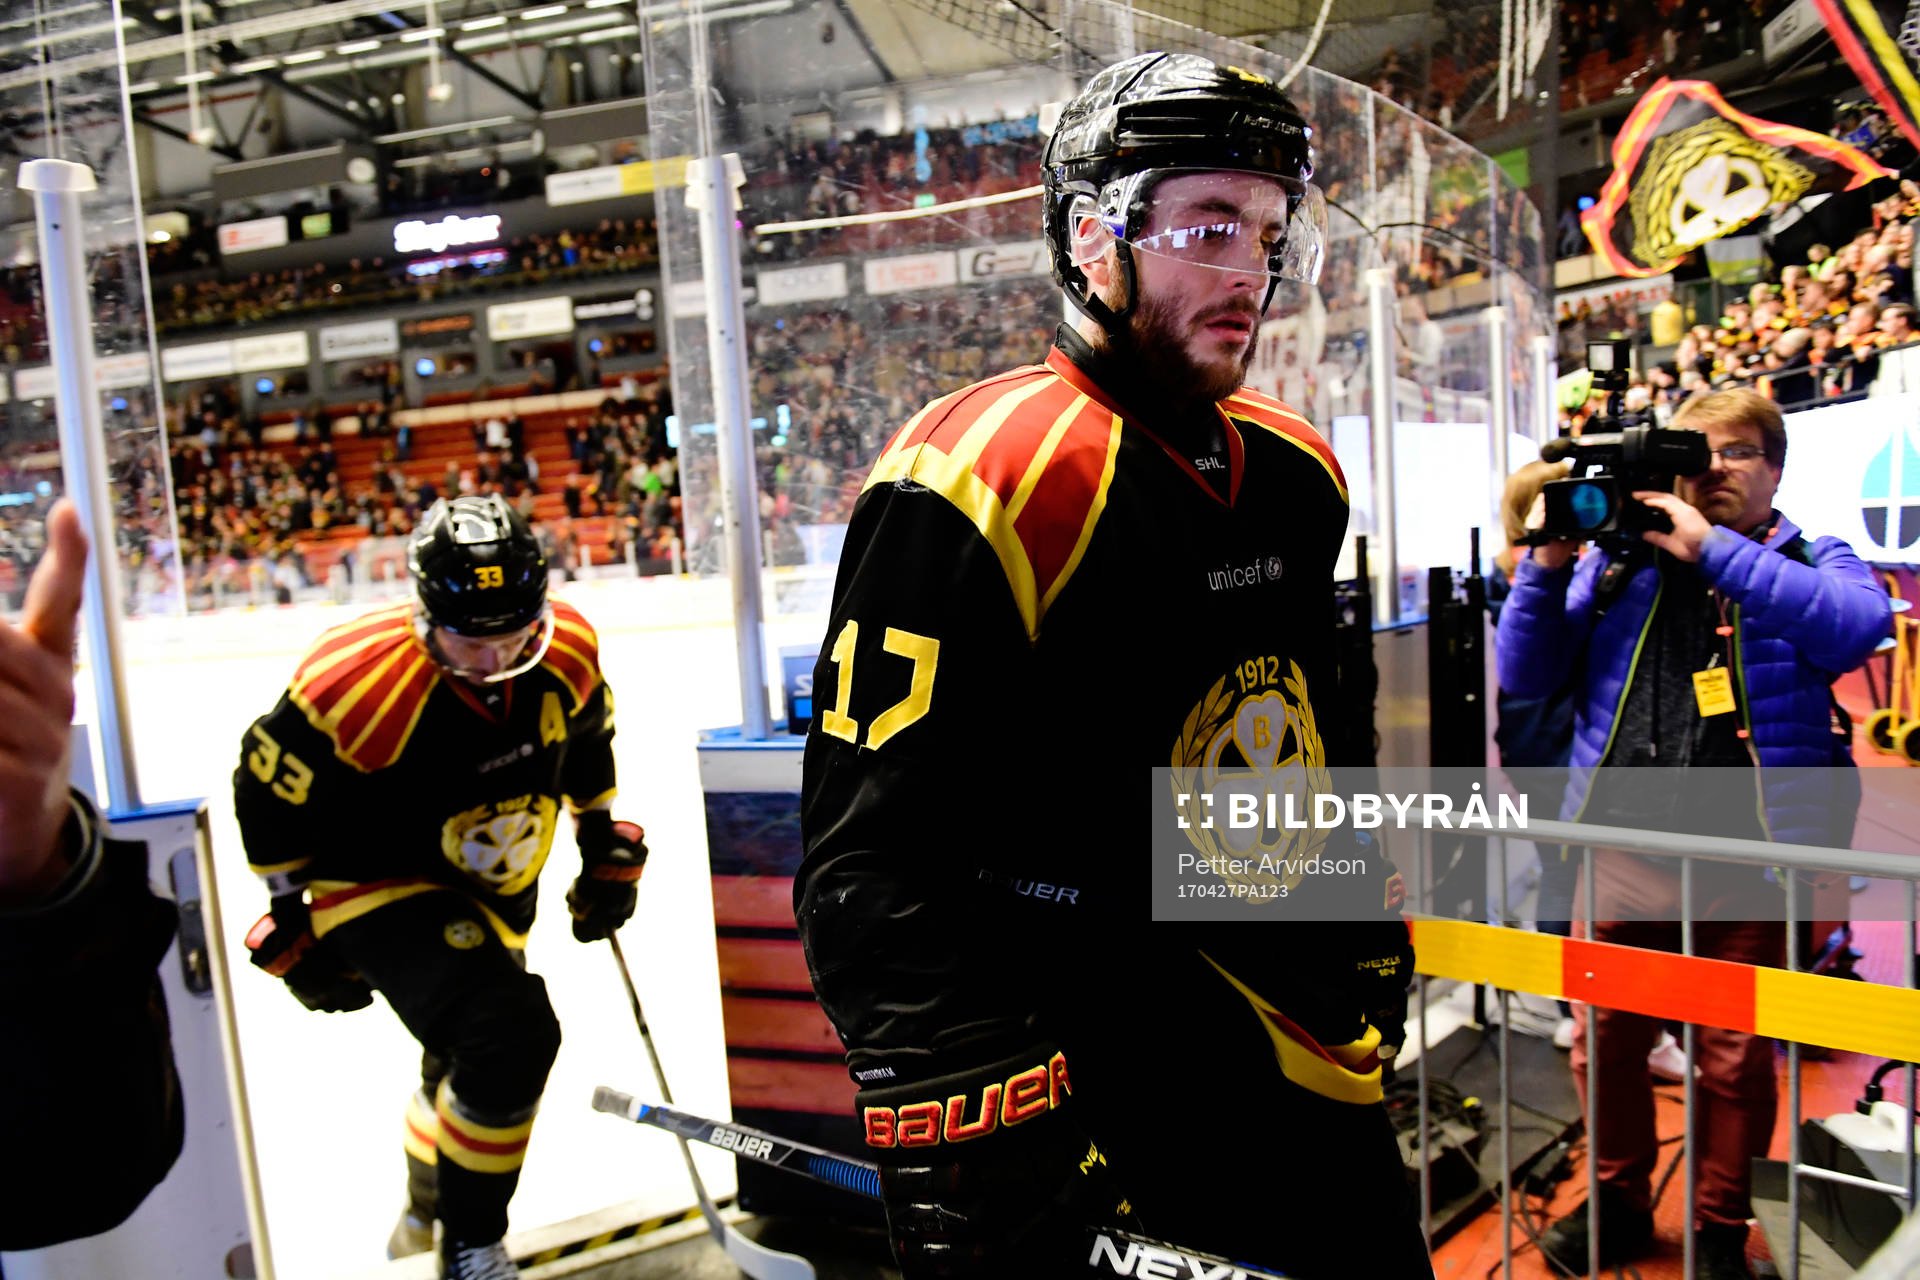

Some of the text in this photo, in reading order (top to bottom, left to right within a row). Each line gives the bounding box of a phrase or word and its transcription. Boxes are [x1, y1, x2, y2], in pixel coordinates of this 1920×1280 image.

[1195, 456, 1225, 471] SHL
[474, 566, 504, 590] 33
[1208, 558, 1262, 591] unicef
[822, 619, 940, 751] 17
[1235, 655, 1279, 693] 1912
[538, 691, 568, 749] A
[1253, 715, 1271, 750] B
[249, 724, 314, 806] 33
[978, 868, 1080, 905] UER
[1088, 1233, 1248, 1280] NEX
